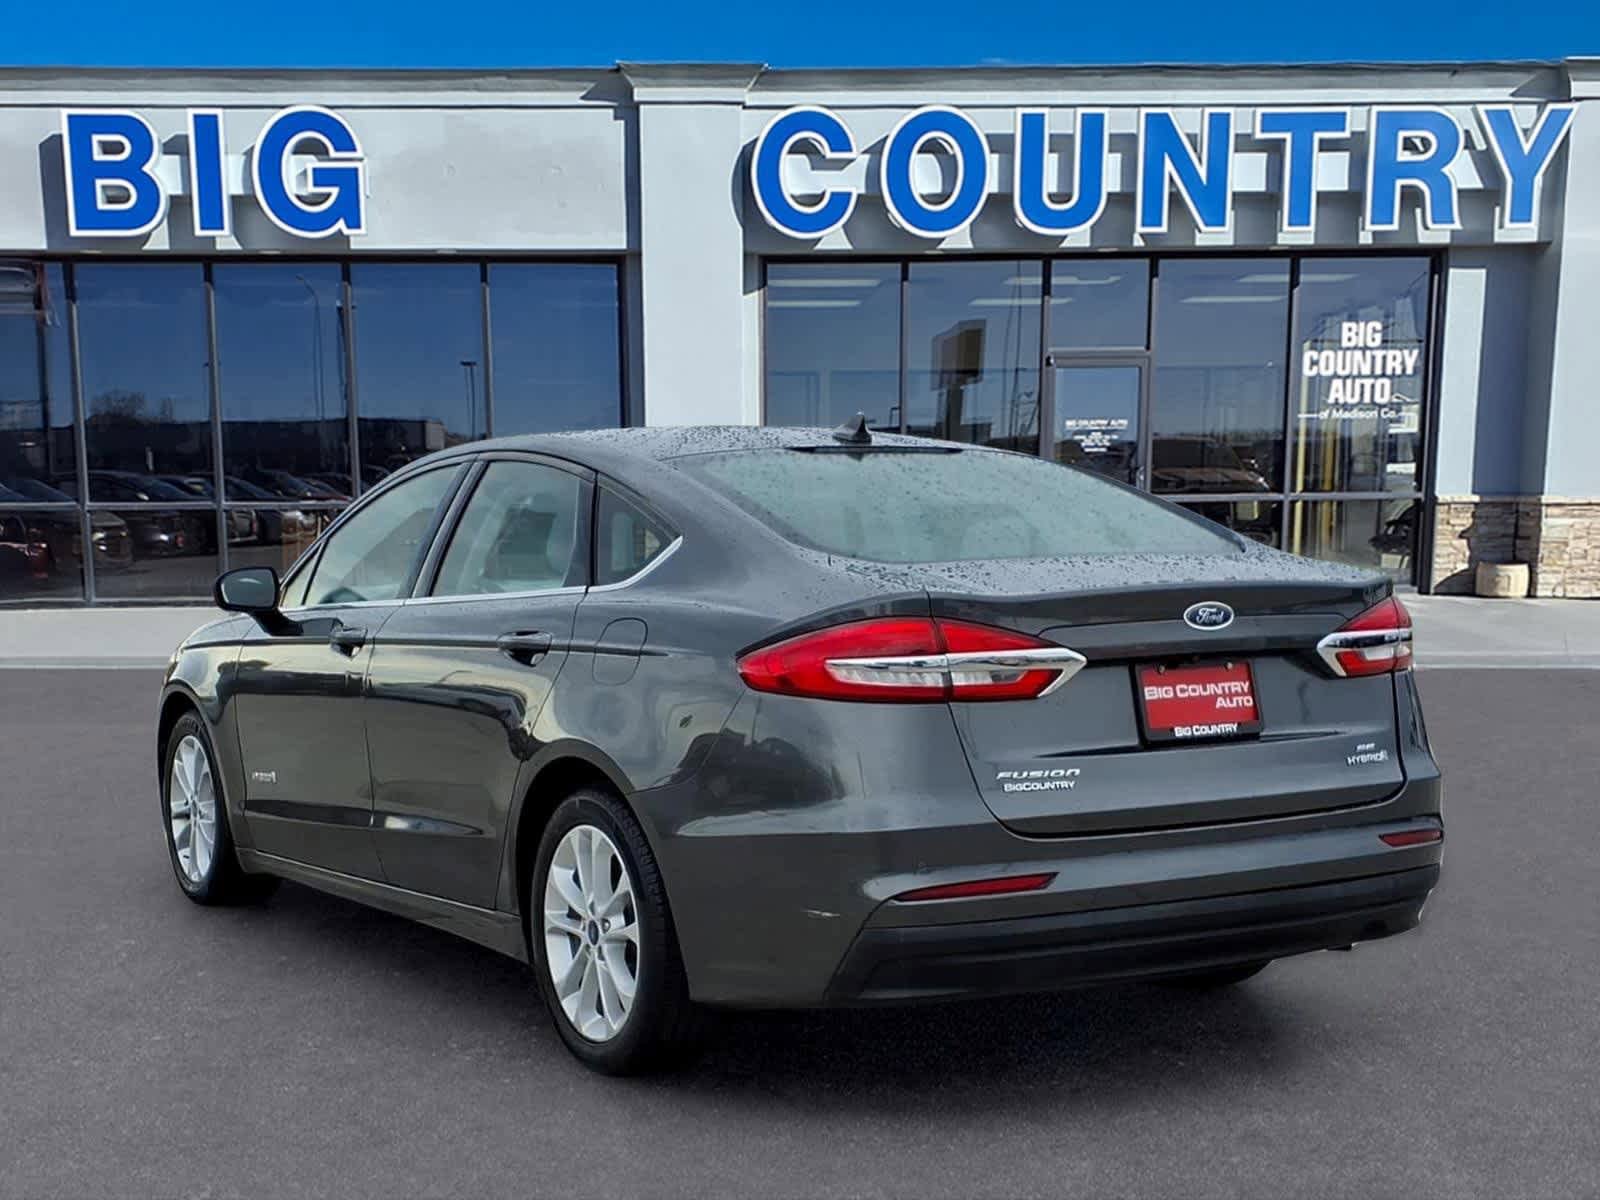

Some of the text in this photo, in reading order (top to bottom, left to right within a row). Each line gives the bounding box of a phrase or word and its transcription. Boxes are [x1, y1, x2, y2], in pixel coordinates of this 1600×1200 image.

[60, 104, 1576, 240] BIG COUNTRY
[1341, 321, 1382, 348] BIG
[1303, 349, 1419, 377] COUNTRY
[1328, 378, 1391, 404] AUTO
[1196, 608, 1224, 624] Ford
[1144, 681, 1250, 700] BIG COUNTRY
[1215, 695, 1253, 709] AUTO
[1174, 722, 1238, 737] BIG COUNTRY
